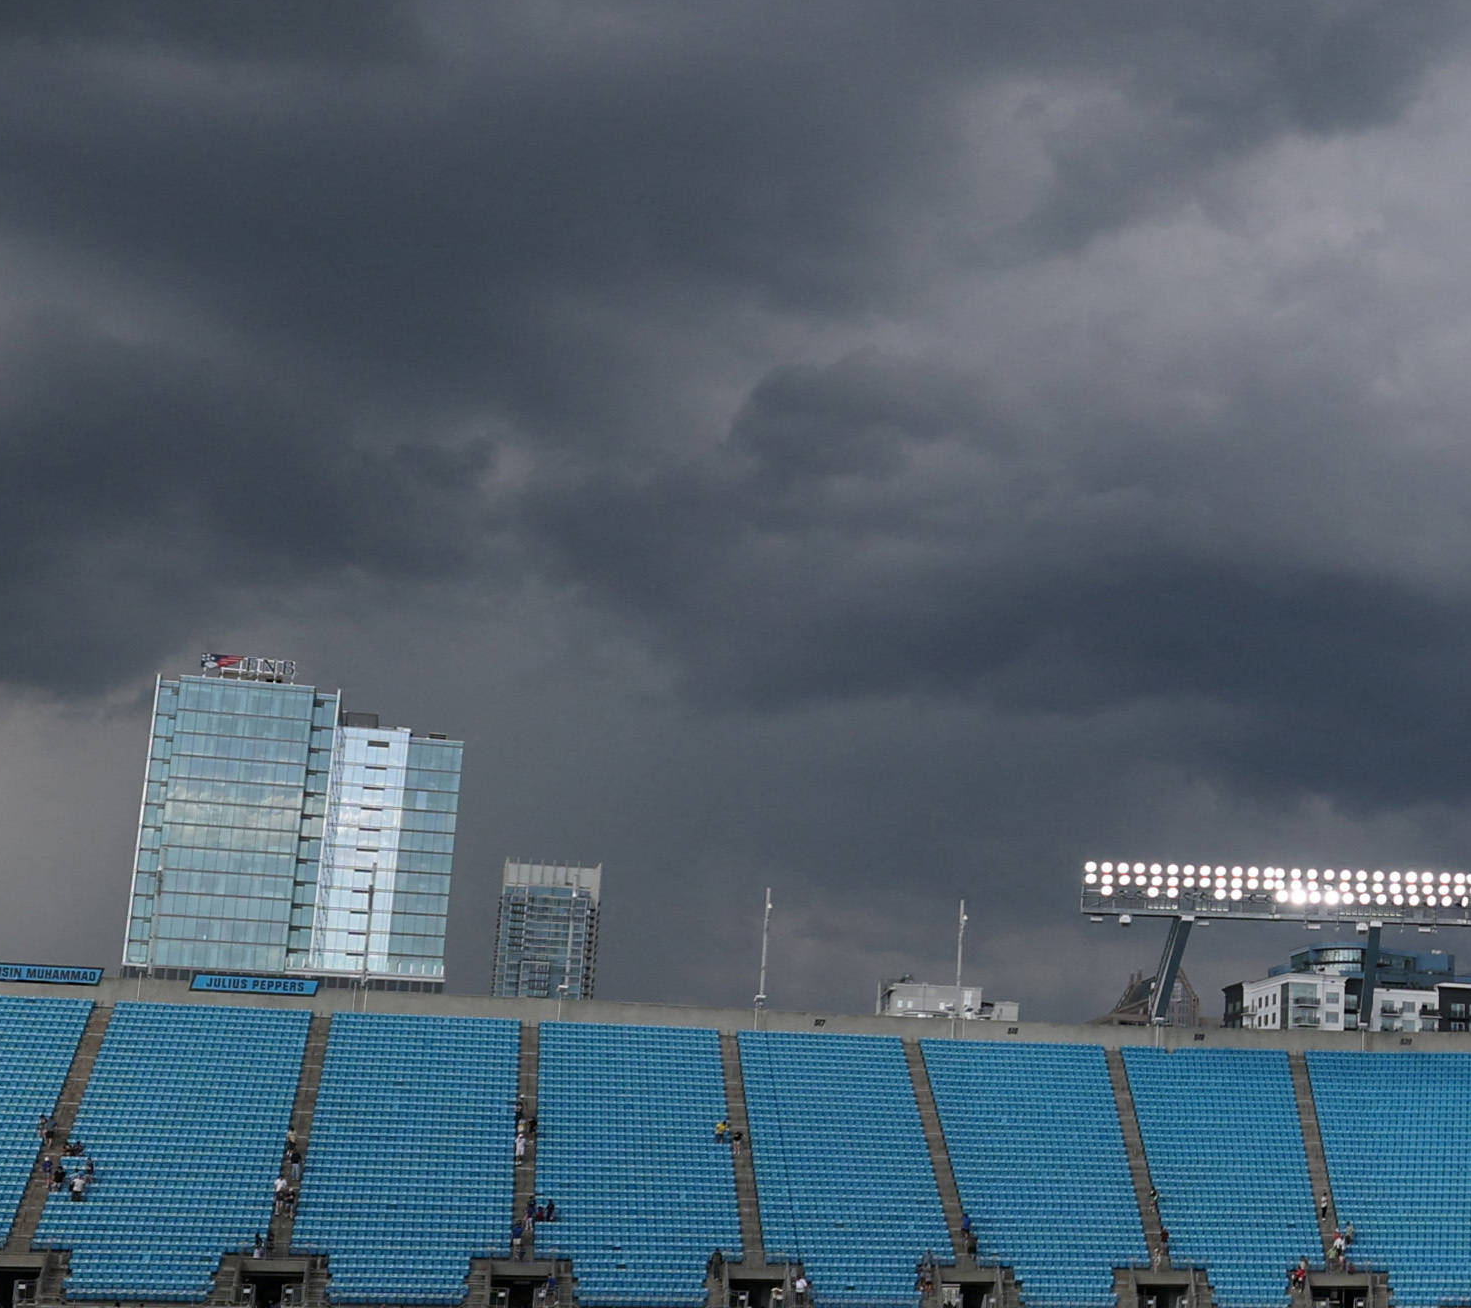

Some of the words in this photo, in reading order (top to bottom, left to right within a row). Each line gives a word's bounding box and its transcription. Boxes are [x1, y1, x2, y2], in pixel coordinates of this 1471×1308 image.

[25, 965, 98, 983] MUHAMMAD
[204, 973, 249, 990] JULIUS
[251, 976, 306, 994] PEPPERS
